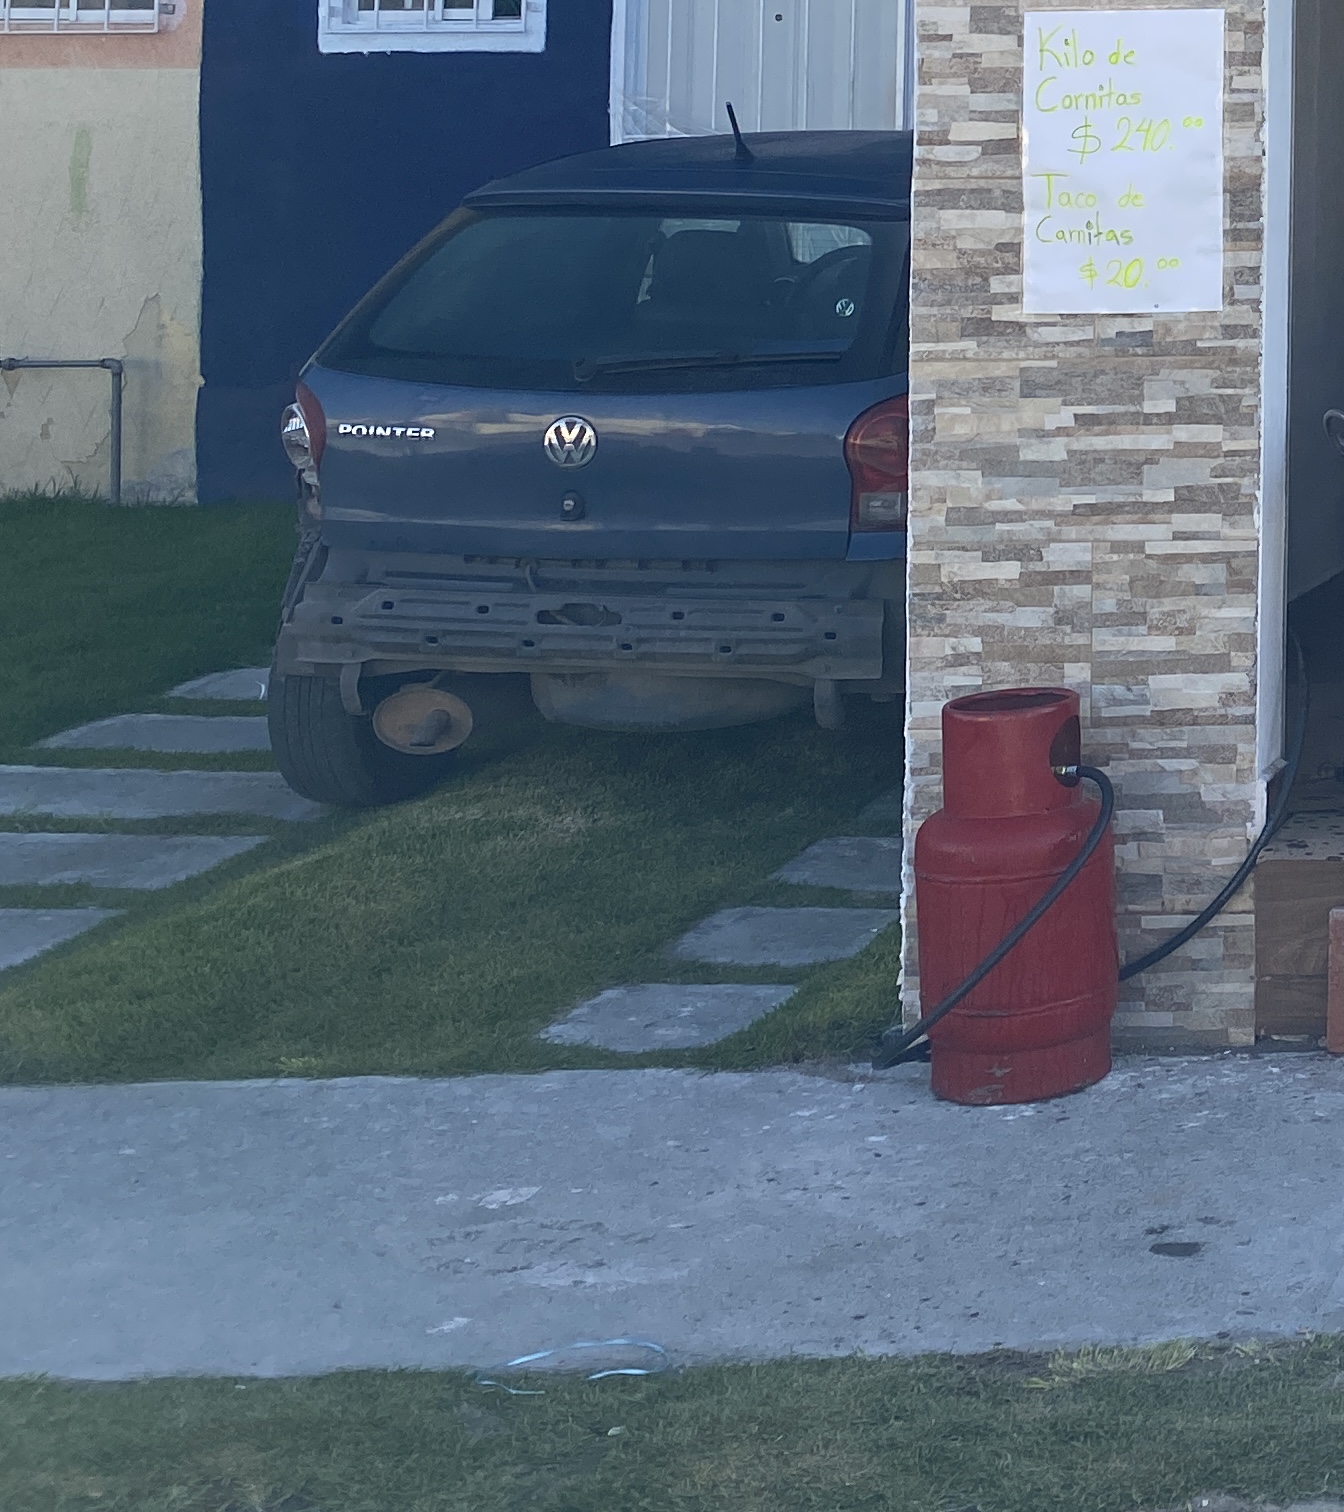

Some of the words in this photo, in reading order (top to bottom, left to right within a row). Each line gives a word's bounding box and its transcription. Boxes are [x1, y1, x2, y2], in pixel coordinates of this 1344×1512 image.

[1037, 24, 1095, 72] Kilo
[1108, 39, 1136, 65] de
[1030, 173, 1098, 210] Taco
[1117, 183, 1145, 209] de
[338, 423, 436, 441] POINTER
